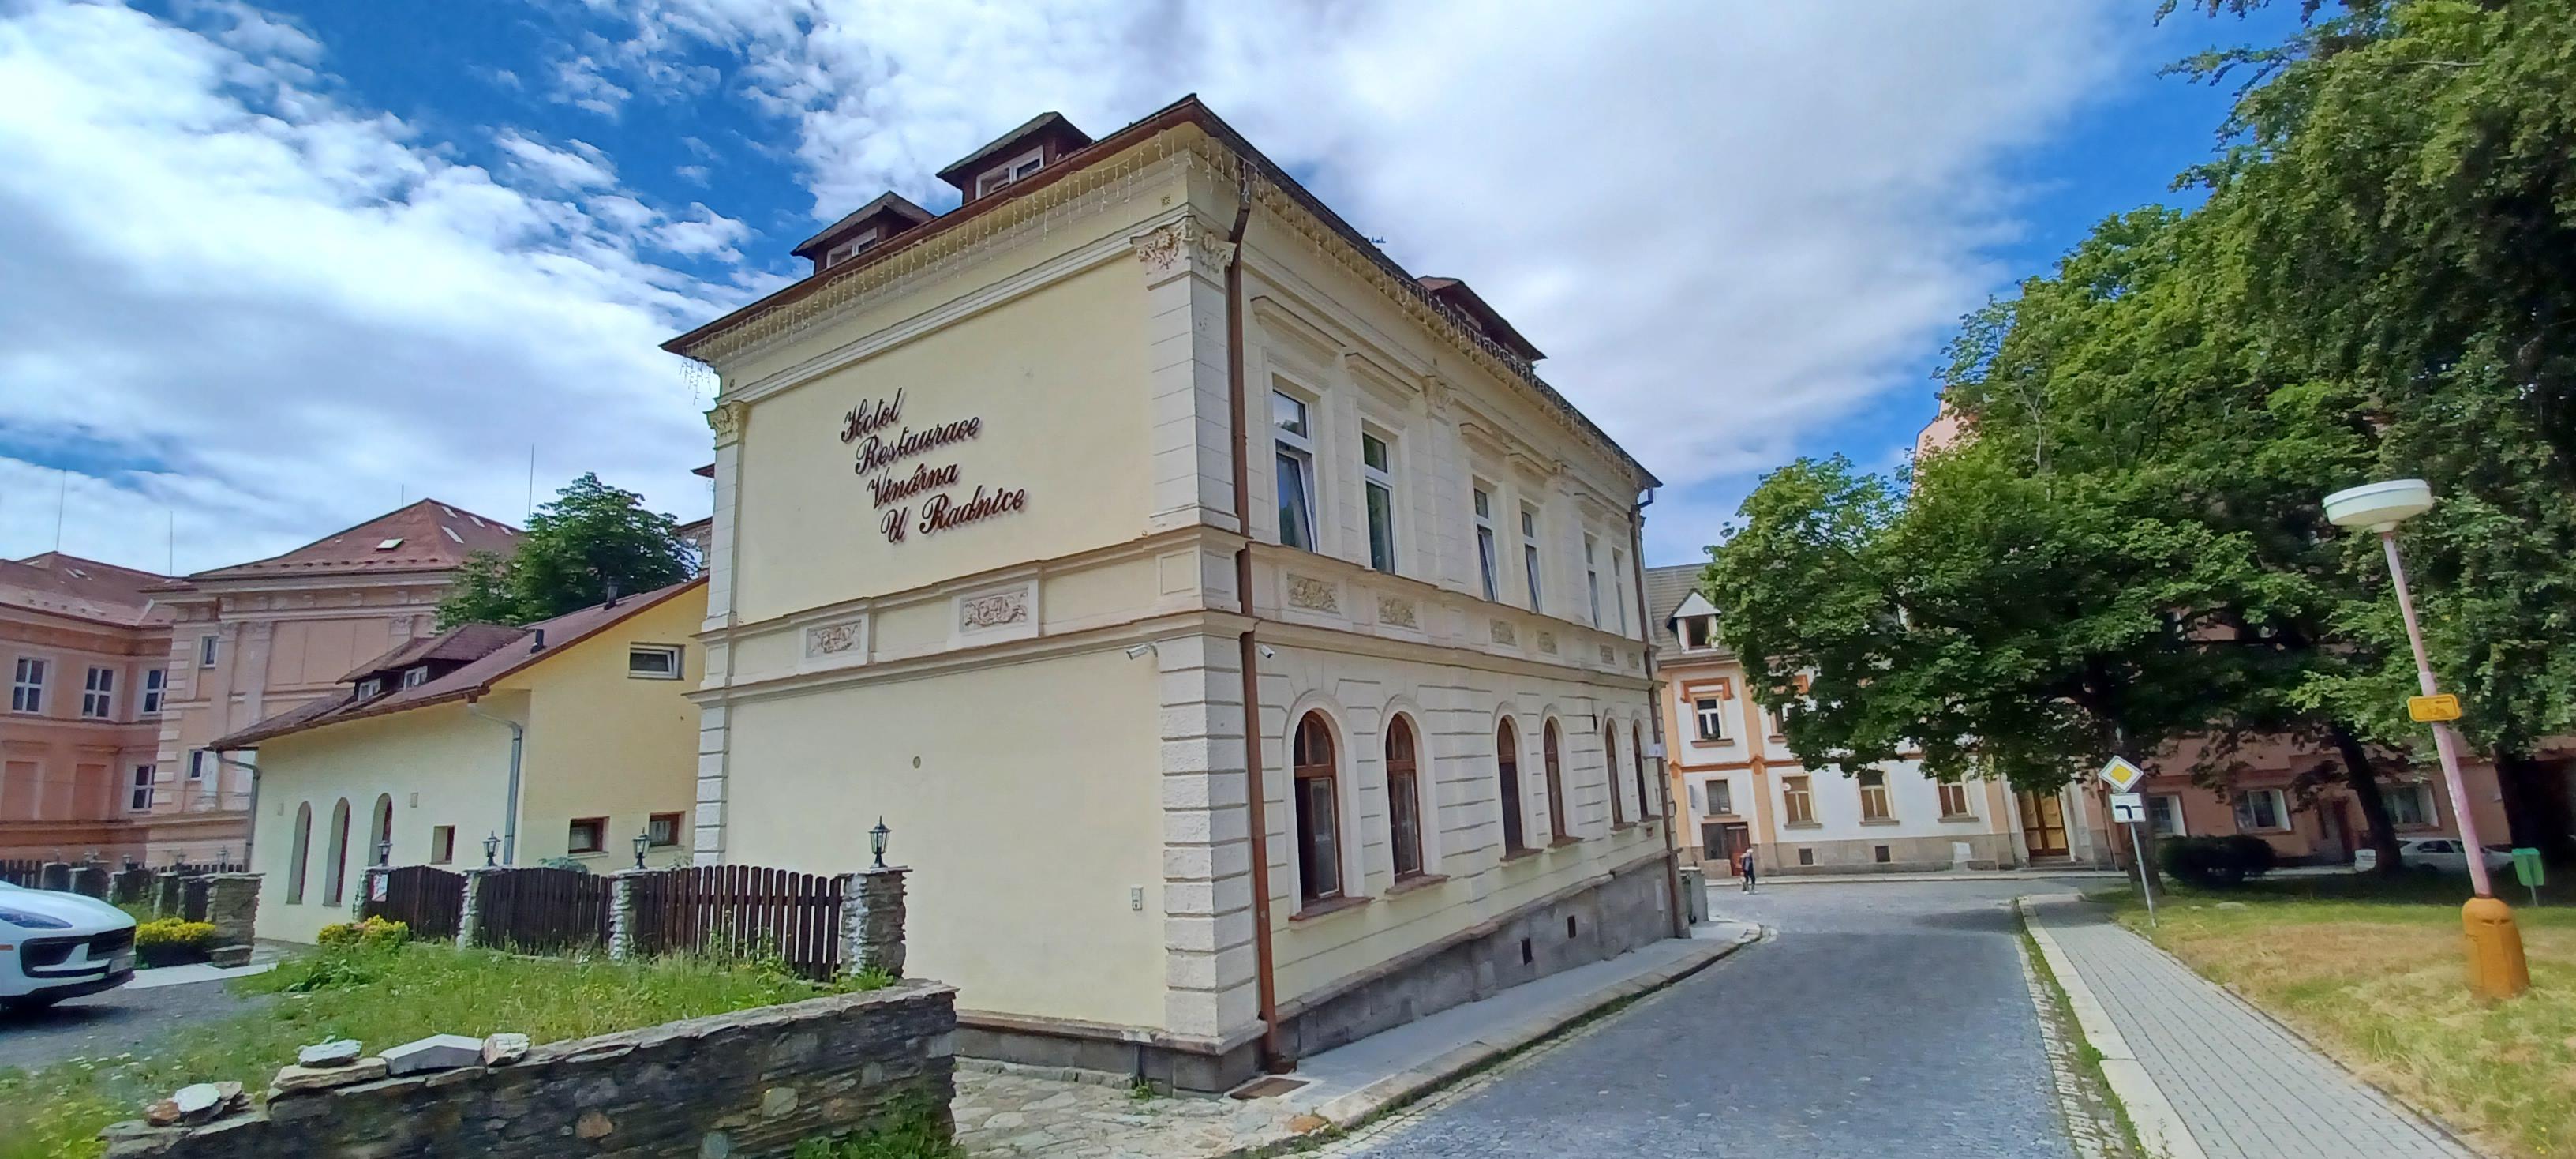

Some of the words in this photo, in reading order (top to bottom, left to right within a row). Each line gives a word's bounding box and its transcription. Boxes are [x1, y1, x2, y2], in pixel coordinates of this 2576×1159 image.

[841, 387, 903, 443] Hotel
[855, 416, 979, 474] Restaurace
[867, 463, 958, 510] Vinárna
[881, 506, 908, 544] U
[919, 485, 1025, 534] Radnice
